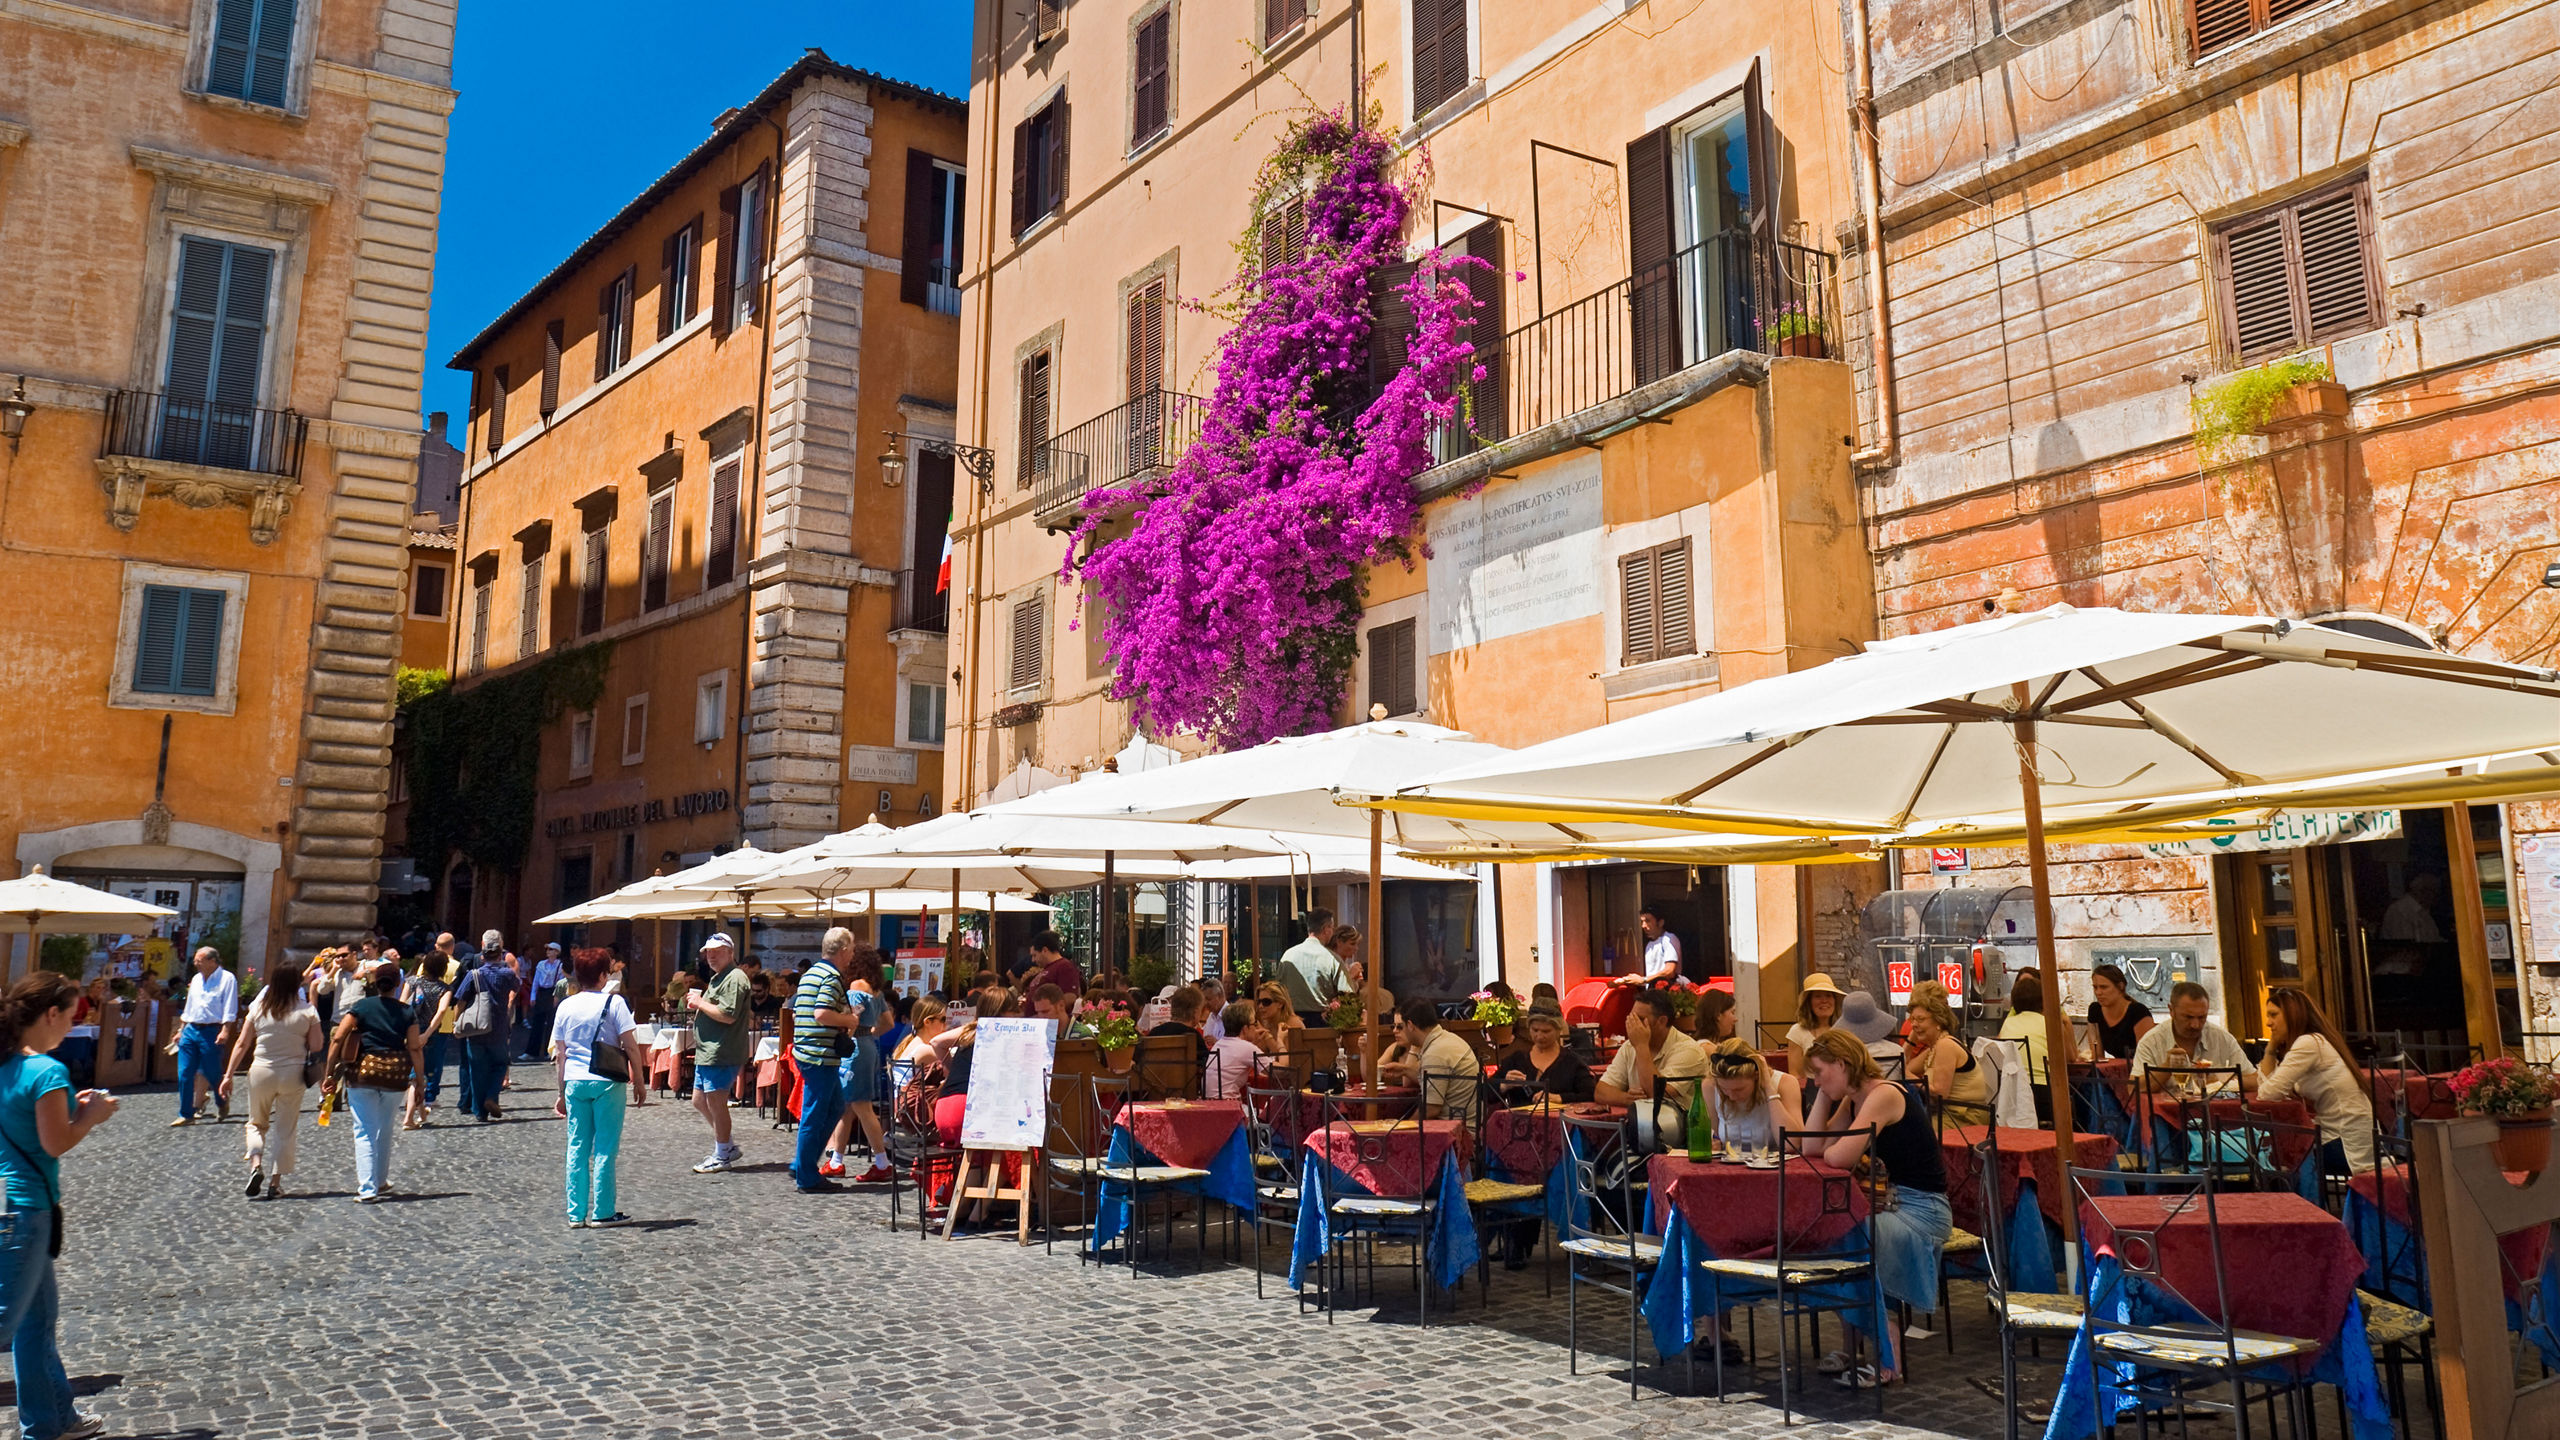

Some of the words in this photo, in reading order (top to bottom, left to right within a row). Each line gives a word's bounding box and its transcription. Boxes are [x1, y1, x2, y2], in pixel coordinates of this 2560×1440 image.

[877, 753, 891, 763] VIA
[673, 789, 729, 818] LAVORO
[1890, 967, 1910, 988] 16
[1941, 969, 1960, 990] 16
